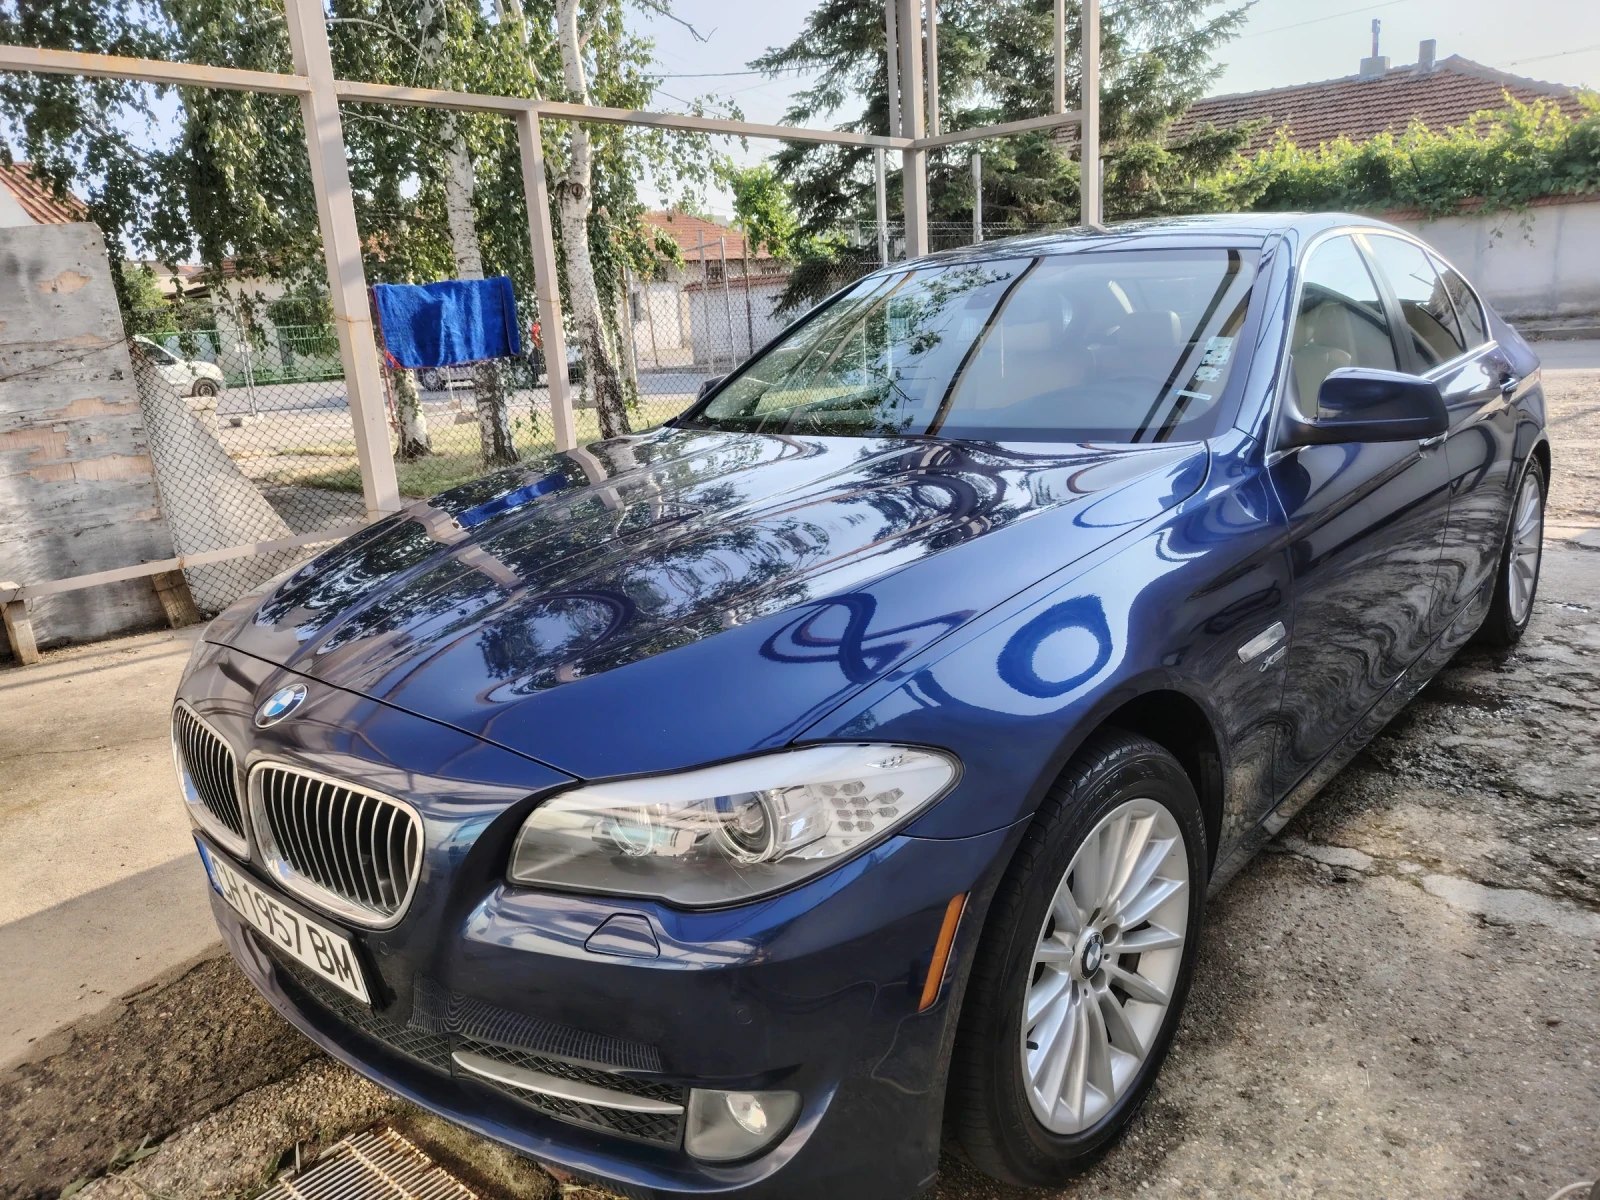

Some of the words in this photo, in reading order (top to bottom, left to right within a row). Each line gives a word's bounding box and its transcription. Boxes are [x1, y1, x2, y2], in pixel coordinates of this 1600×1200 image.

[211, 855, 247, 914] CH
[242, 883, 302, 955] 1957
[306, 923, 359, 991] BM
